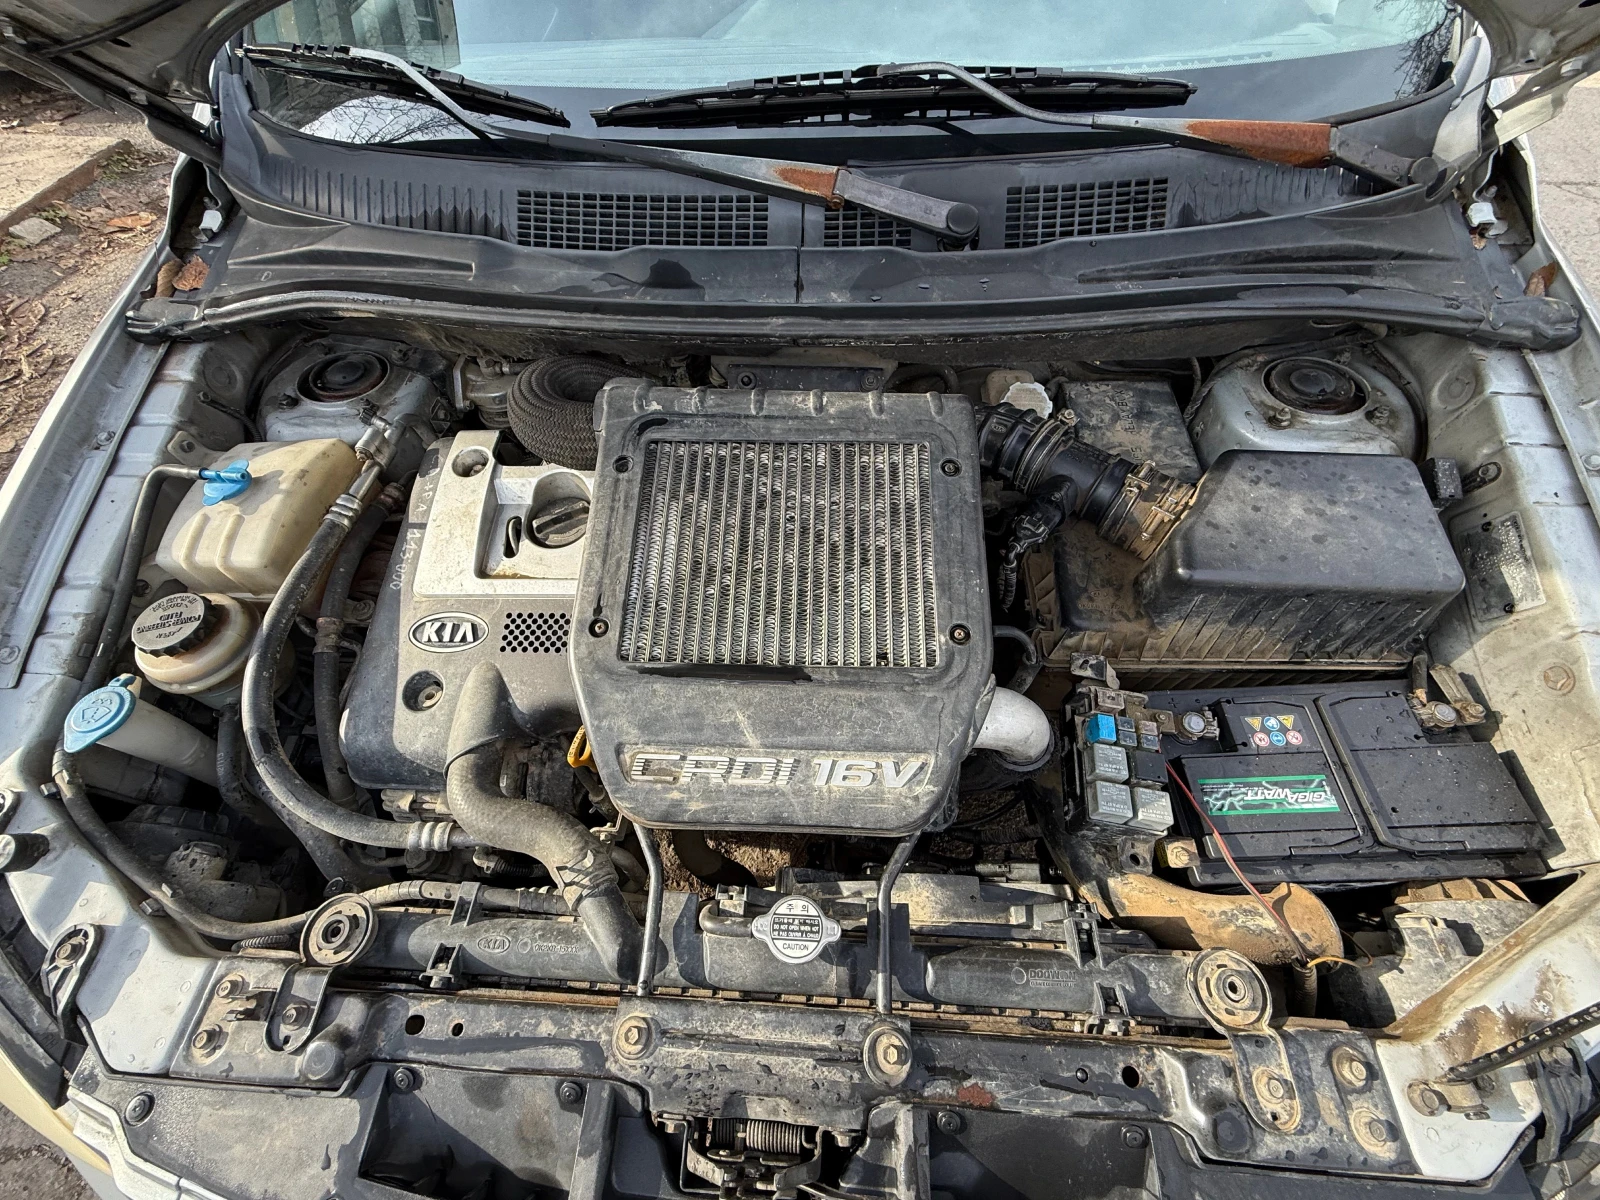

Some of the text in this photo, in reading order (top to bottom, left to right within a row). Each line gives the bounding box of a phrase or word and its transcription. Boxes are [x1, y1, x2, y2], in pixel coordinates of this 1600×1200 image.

[159, 611, 183, 621] FLUID
[136, 614, 202, 634] POWER STEERING
[421, 621, 474, 642] KIA
[813, 758, 928, 788] 16V
[1243, 788, 1326, 802] GIGAWATT
[482, 938, 506, 950] KIA
[782, 942, 809, 951] CAUTION
